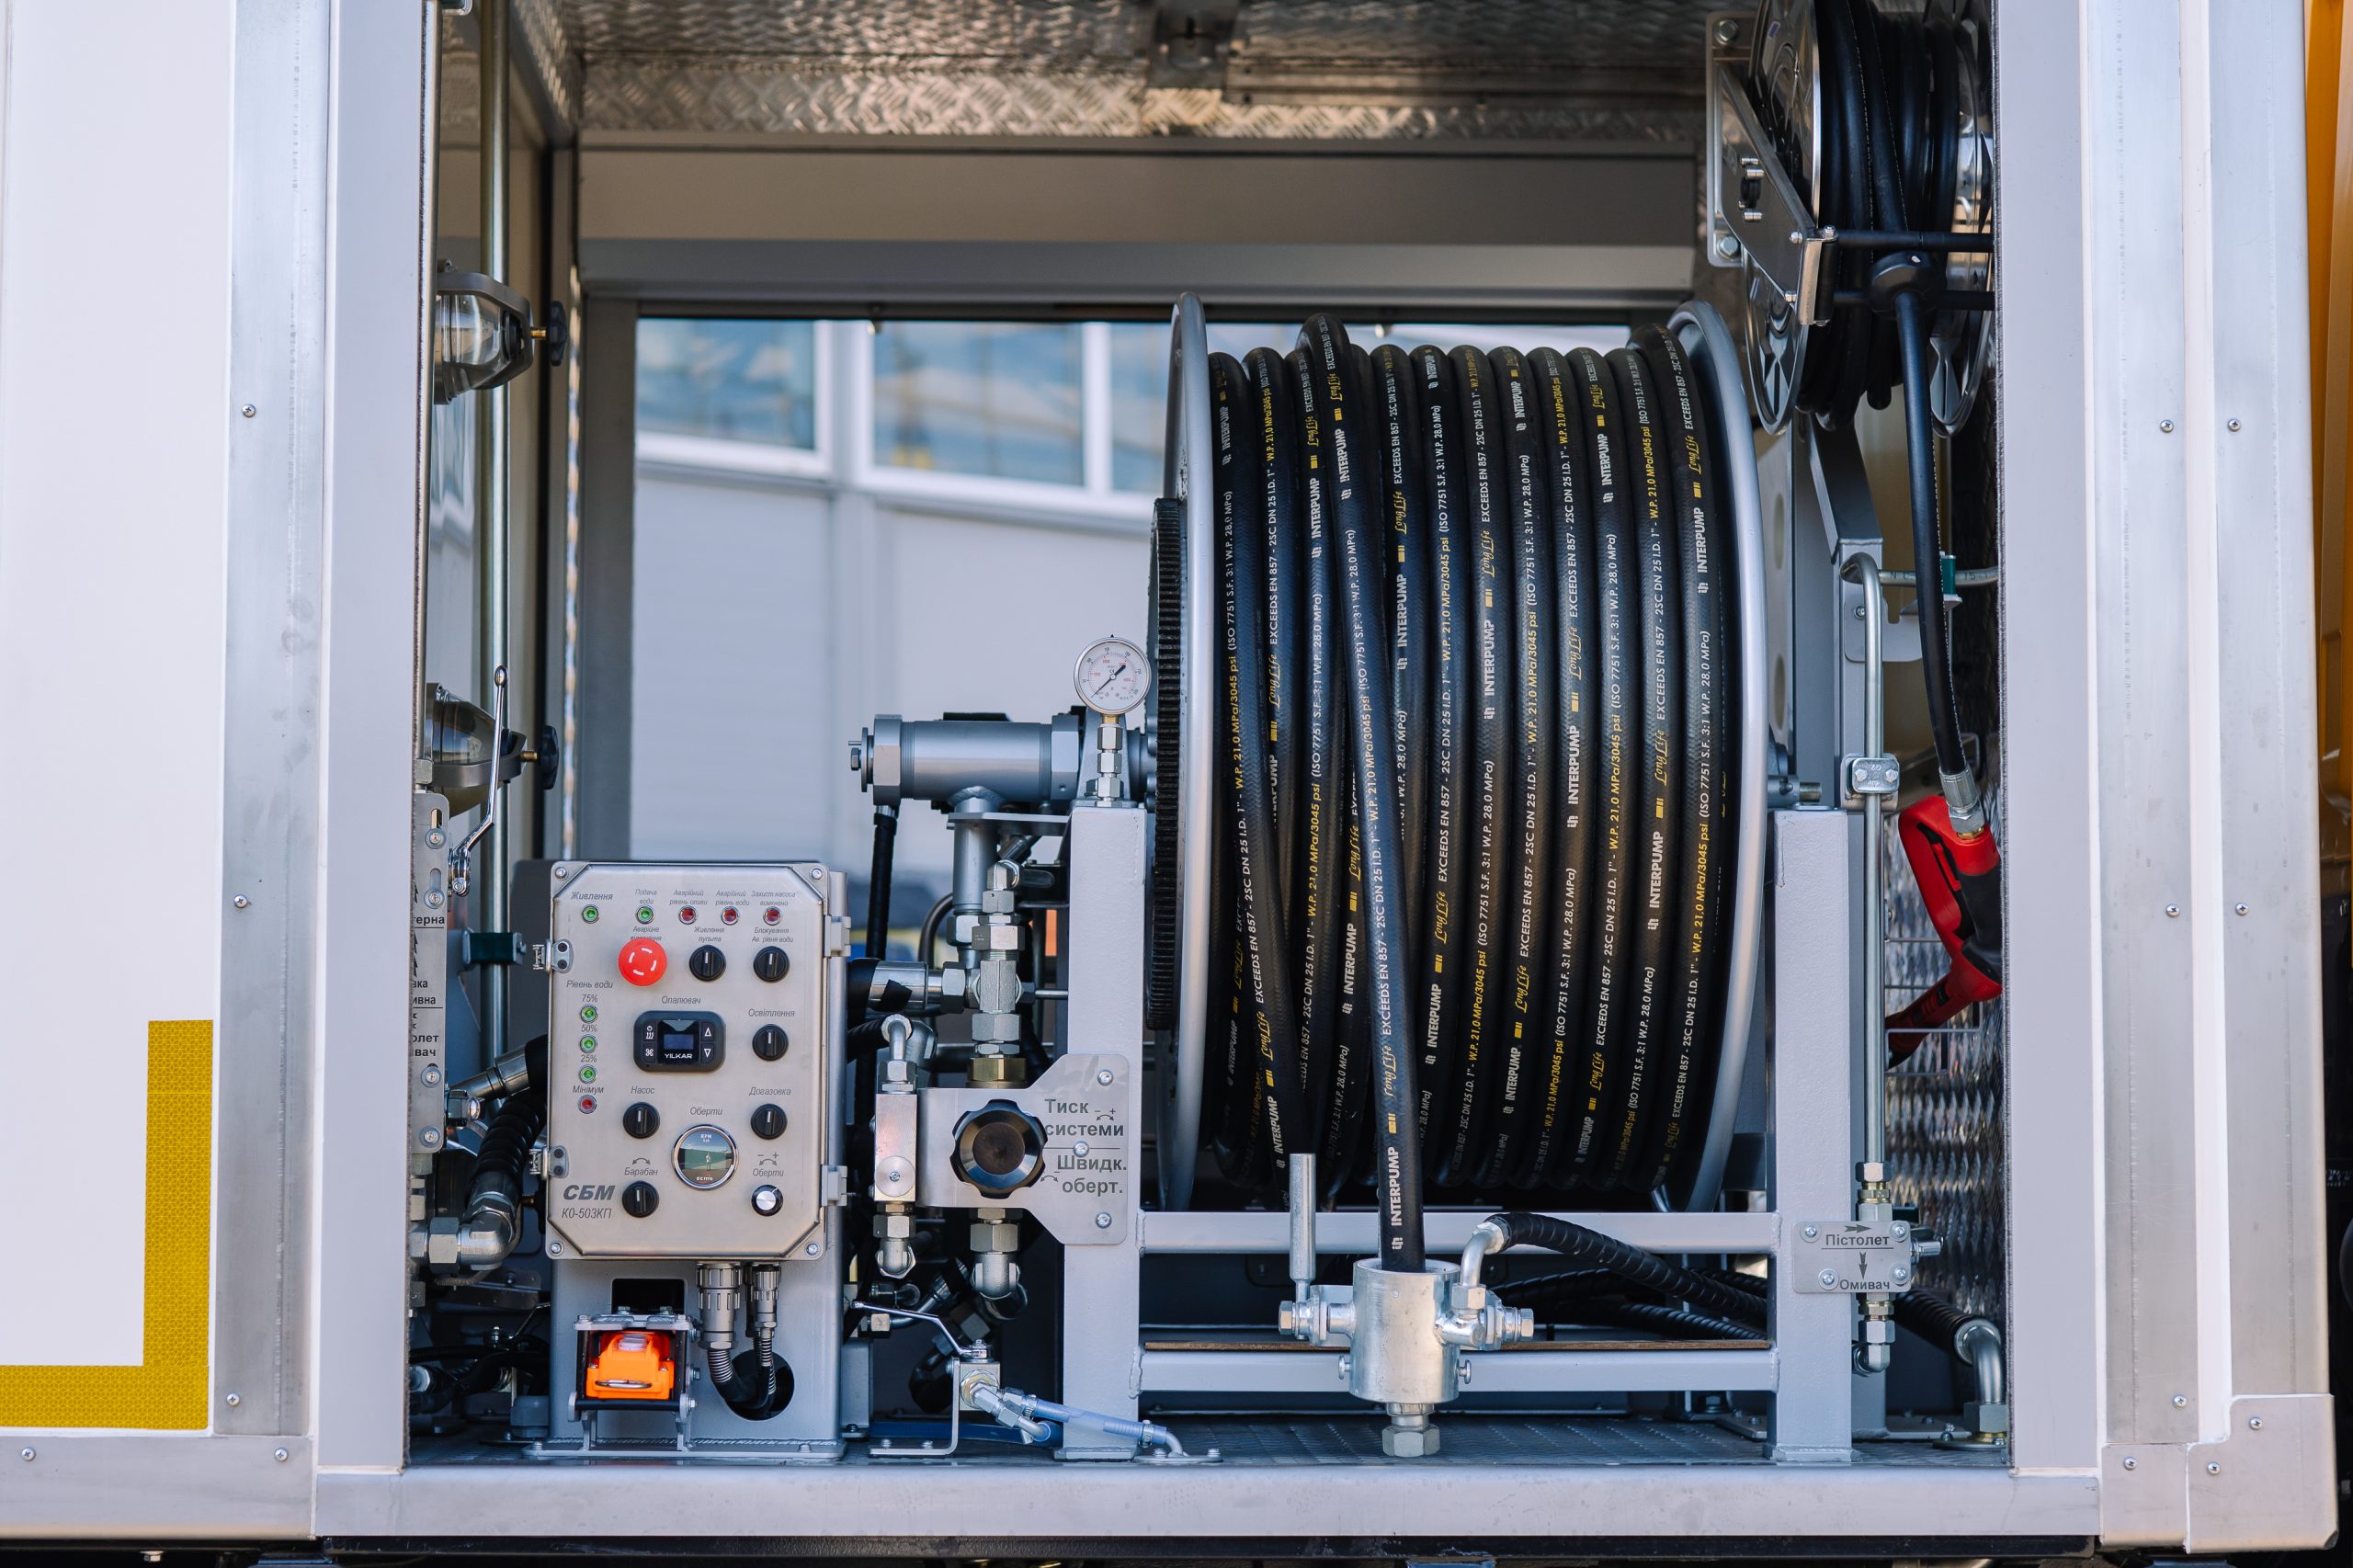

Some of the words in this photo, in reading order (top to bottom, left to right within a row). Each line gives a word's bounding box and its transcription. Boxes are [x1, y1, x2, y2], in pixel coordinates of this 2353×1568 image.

[1511, 381, 1525, 418] INTERPUMP
[1390, 422, 1399, 435] 857
[1391, 436, 1400, 446] EN
[1335, 428, 1349, 483] INTERPUMP
[1392, 447, 1403, 484] EXCEEDS
[1477, 452, 1487, 467] 857
[1597, 434, 1612, 486] INTERPUMP
[1478, 468, 1488, 480] EN
[1310, 477, 1322, 539] INTERPUMP
[1438, 489, 1447, 510] 7751
[1480, 482, 1490, 522] EXCEEDS
[1267, 508, 1277, 524] DN
[1268, 526, 1277, 546] 2SC
[1566, 532, 1576, 551] 857
[1693, 506, 1708, 574] INTERPUMP
[1268, 556, 1278, 575] 857
[1567, 552, 1576, 567] EN
[1269, 577, 1278, 592] EN
[1568, 569, 1578, 618] EXCEEDS
[1269, 595, 1278, 644] EXCEEDS
[1396, 574, 1407, 647] INTERPUMP
[1527, 611, 1539, 628] psi
[1655, 626, 1665, 647] 857
[1354, 642, 1366, 665] 7751
[1483, 619, 1495, 696] INTERPUMP
[1528, 630, 1537, 687] MPa/3045
[1655, 649, 1665, 665] EN
[1229, 675, 1239, 733] MPa/3045
[1656, 667, 1665, 721] EXCEEDS
[1611, 714, 1622, 733] psi
[1441, 750, 1450, 774] 2SC
[1567, 725, 1580, 804] INTERPUMP
[1610, 734, 1620, 795] MPa/3045
[1234, 764, 1244, 789] W.P.
[1700, 762, 1710, 789] 7751
[1312, 783, 1322, 801] psi
[1440, 785, 1449, 808] 857
[1440, 810, 1449, 826] EN
[1310, 803, 1320, 863] MPa/3045
[1699, 823, 1710, 841] psi
[1525, 832, 1535, 856] 2SC
[1438, 829, 1449, 882] EXCEEDS
[1241, 857, 1250, 875] DN
[1650, 831, 1663, 908] INTERPUMP
[1696, 843, 1707, 902] MPa/3045
[1524, 866, 1533, 888] 857
[571, 891, 613, 901] Живлення
[1243, 878, 1253, 902] 2SC
[1522, 890, 1532, 905] EN
[414, 915, 445, 926] ерна
[1246, 912, 1256, 933] 857
[1375, 906, 1386, 928] 2SC
[1519, 908, 1531, 958] EXCEEDS
[1249, 936, 1258, 951] EN
[1376, 939, 1388, 961] 857
[1604, 934, 1614, 957] 2SC
[1344, 923, 1357, 994] INTERPUMP
[1477, 949, 1487, 967] psi
[1251, 953, 1264, 1004] EXCEEDS
[1304, 962, 1314, 977] 25
[1376, 961, 1389, 980] EN
[1558, 991, 1568, 1014] 7751
[1563, 927, 1573, 949] W.P.
[1601, 965, 1611, 985] 857
[566, 980, 593, 989] Рівень
[594, 980, 613, 989] води
[1304, 977, 1313, 995] DN
[1473, 968, 1484, 1019] MPa/3045
[1600, 986, 1609, 1002] EN
[582, 994, 598, 1003] 75%
[661, 995, 701, 1005] Опалювач
[1302, 996, 1313, 1018] 2SC
[748, 1007, 795, 1017] Освітлення
[1378, 982, 1392, 1036] EXCEEDS
[1427, 983, 1441, 1048] INTERPUMP
[1596, 1003, 1608, 1046] EXCEEDS
[580, 1054, 597, 1062] 25%
[1679, 1054, 1689, 1071] 857
[1506, 1047, 1520, 1101] INTERPUMP
[1631, 1073, 1642, 1091] 7751
[1677, 1072, 1687, 1084] EN
[572, 1085, 605, 1095] Мінімум
[631, 1085, 655, 1095] Насос
[748, 1086, 791, 1096] Догазовка
[1044, 1098, 1089, 1114] Тиск
[1672, 1085, 1685, 1118] EXCEEDS
[689, 1107, 722, 1117] Оберти
[1045, 1123, 1124, 1136] системи
[1267, 1096, 1283, 1154] INTERPUMP
[624, 1166, 659, 1176] Барабан
[752, 1167, 784, 1178] Оберти
[1057, 1154, 1127, 1172] Швидк.
[563, 1184, 616, 1200] СБМ
[1062, 1177, 1123, 1197] оберт.
[1388, 1146, 1402, 1226] INTERPUMP
[1825, 1233, 1890, 1246] Пістолет
[1839, 1278, 1890, 1290] Омивач
